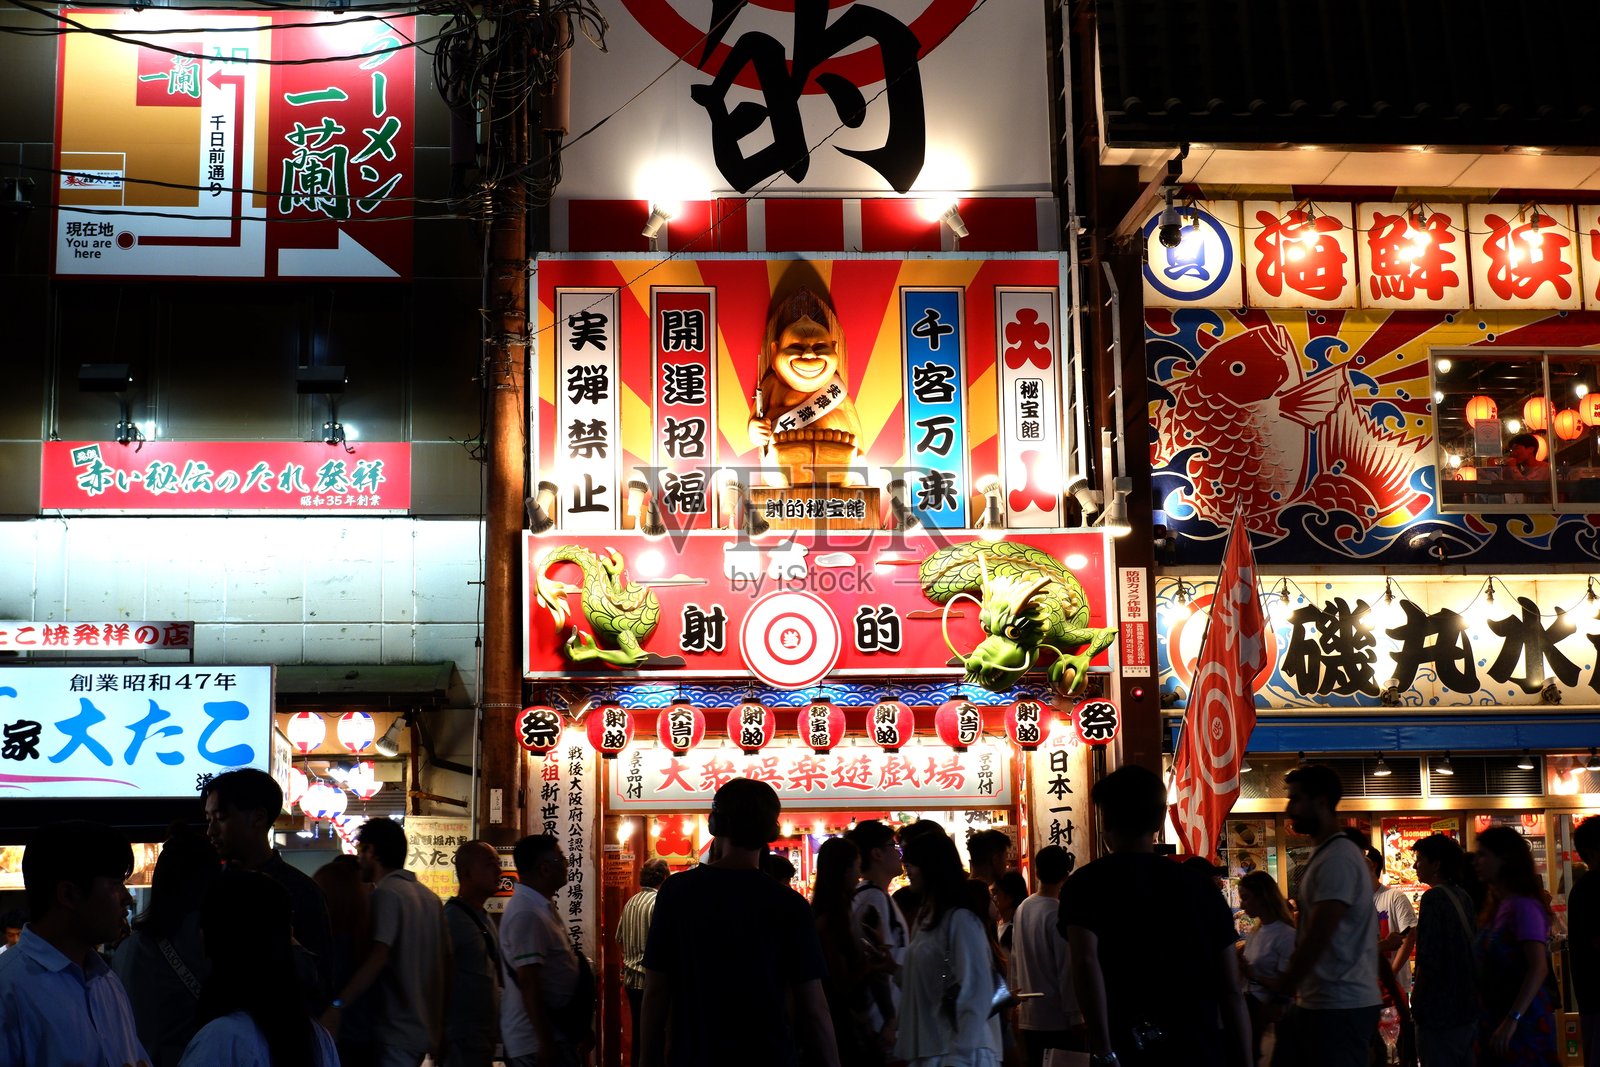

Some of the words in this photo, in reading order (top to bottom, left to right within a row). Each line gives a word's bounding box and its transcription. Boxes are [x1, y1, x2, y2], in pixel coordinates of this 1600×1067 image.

[139, 51, 201, 98] 一蘭
[210, 46, 249, 64] 入口
[350, 20, 402, 213] ラーメン
[691, 0, 925, 194] 的
[208, 115, 226, 197] 千日前通り
[279, 86, 351, 219] 一蘭
[66, 222, 114, 237] 現在地
[66, 238, 88, 248] You
[93, 240, 112, 248] are
[74, 249, 102, 258] here
[1254, 209, 1600, 301] 海鮮浜
[567, 310, 609, 514] 実弾禁止
[661, 309, 707, 514] 開運招福
[912, 308, 958, 513] 千客万来
[1020, 381, 1040, 439] 秘宝館
[76, 459, 386, 497] 赤い秘伝のたれ発祥
[300, 495, 381, 506] 昭和35年創業
[766, 499, 865, 518] 射的秘宝館
[1126, 571, 1141, 618] 防犯カメラ作動中
[1282, 597, 1600, 696] 磯丸水
[69, 673, 237, 692] 創業昭和47年
[48, 696, 256, 767] 大たこ
[522, 710, 560, 747] 祭
[603, 709, 627, 748] 射的
[741, 706, 765, 746] 射的
[810, 706, 830, 746] 秘宝館
[875, 705, 899, 744] 射的
[958, 703, 978, 743] 大当り
[1016, 703, 1040, 742] 射的
[1042, 732, 1079, 748] 世界
[1080, 703, 1118, 739] 祭
[626, 751, 643, 799] 景品付
